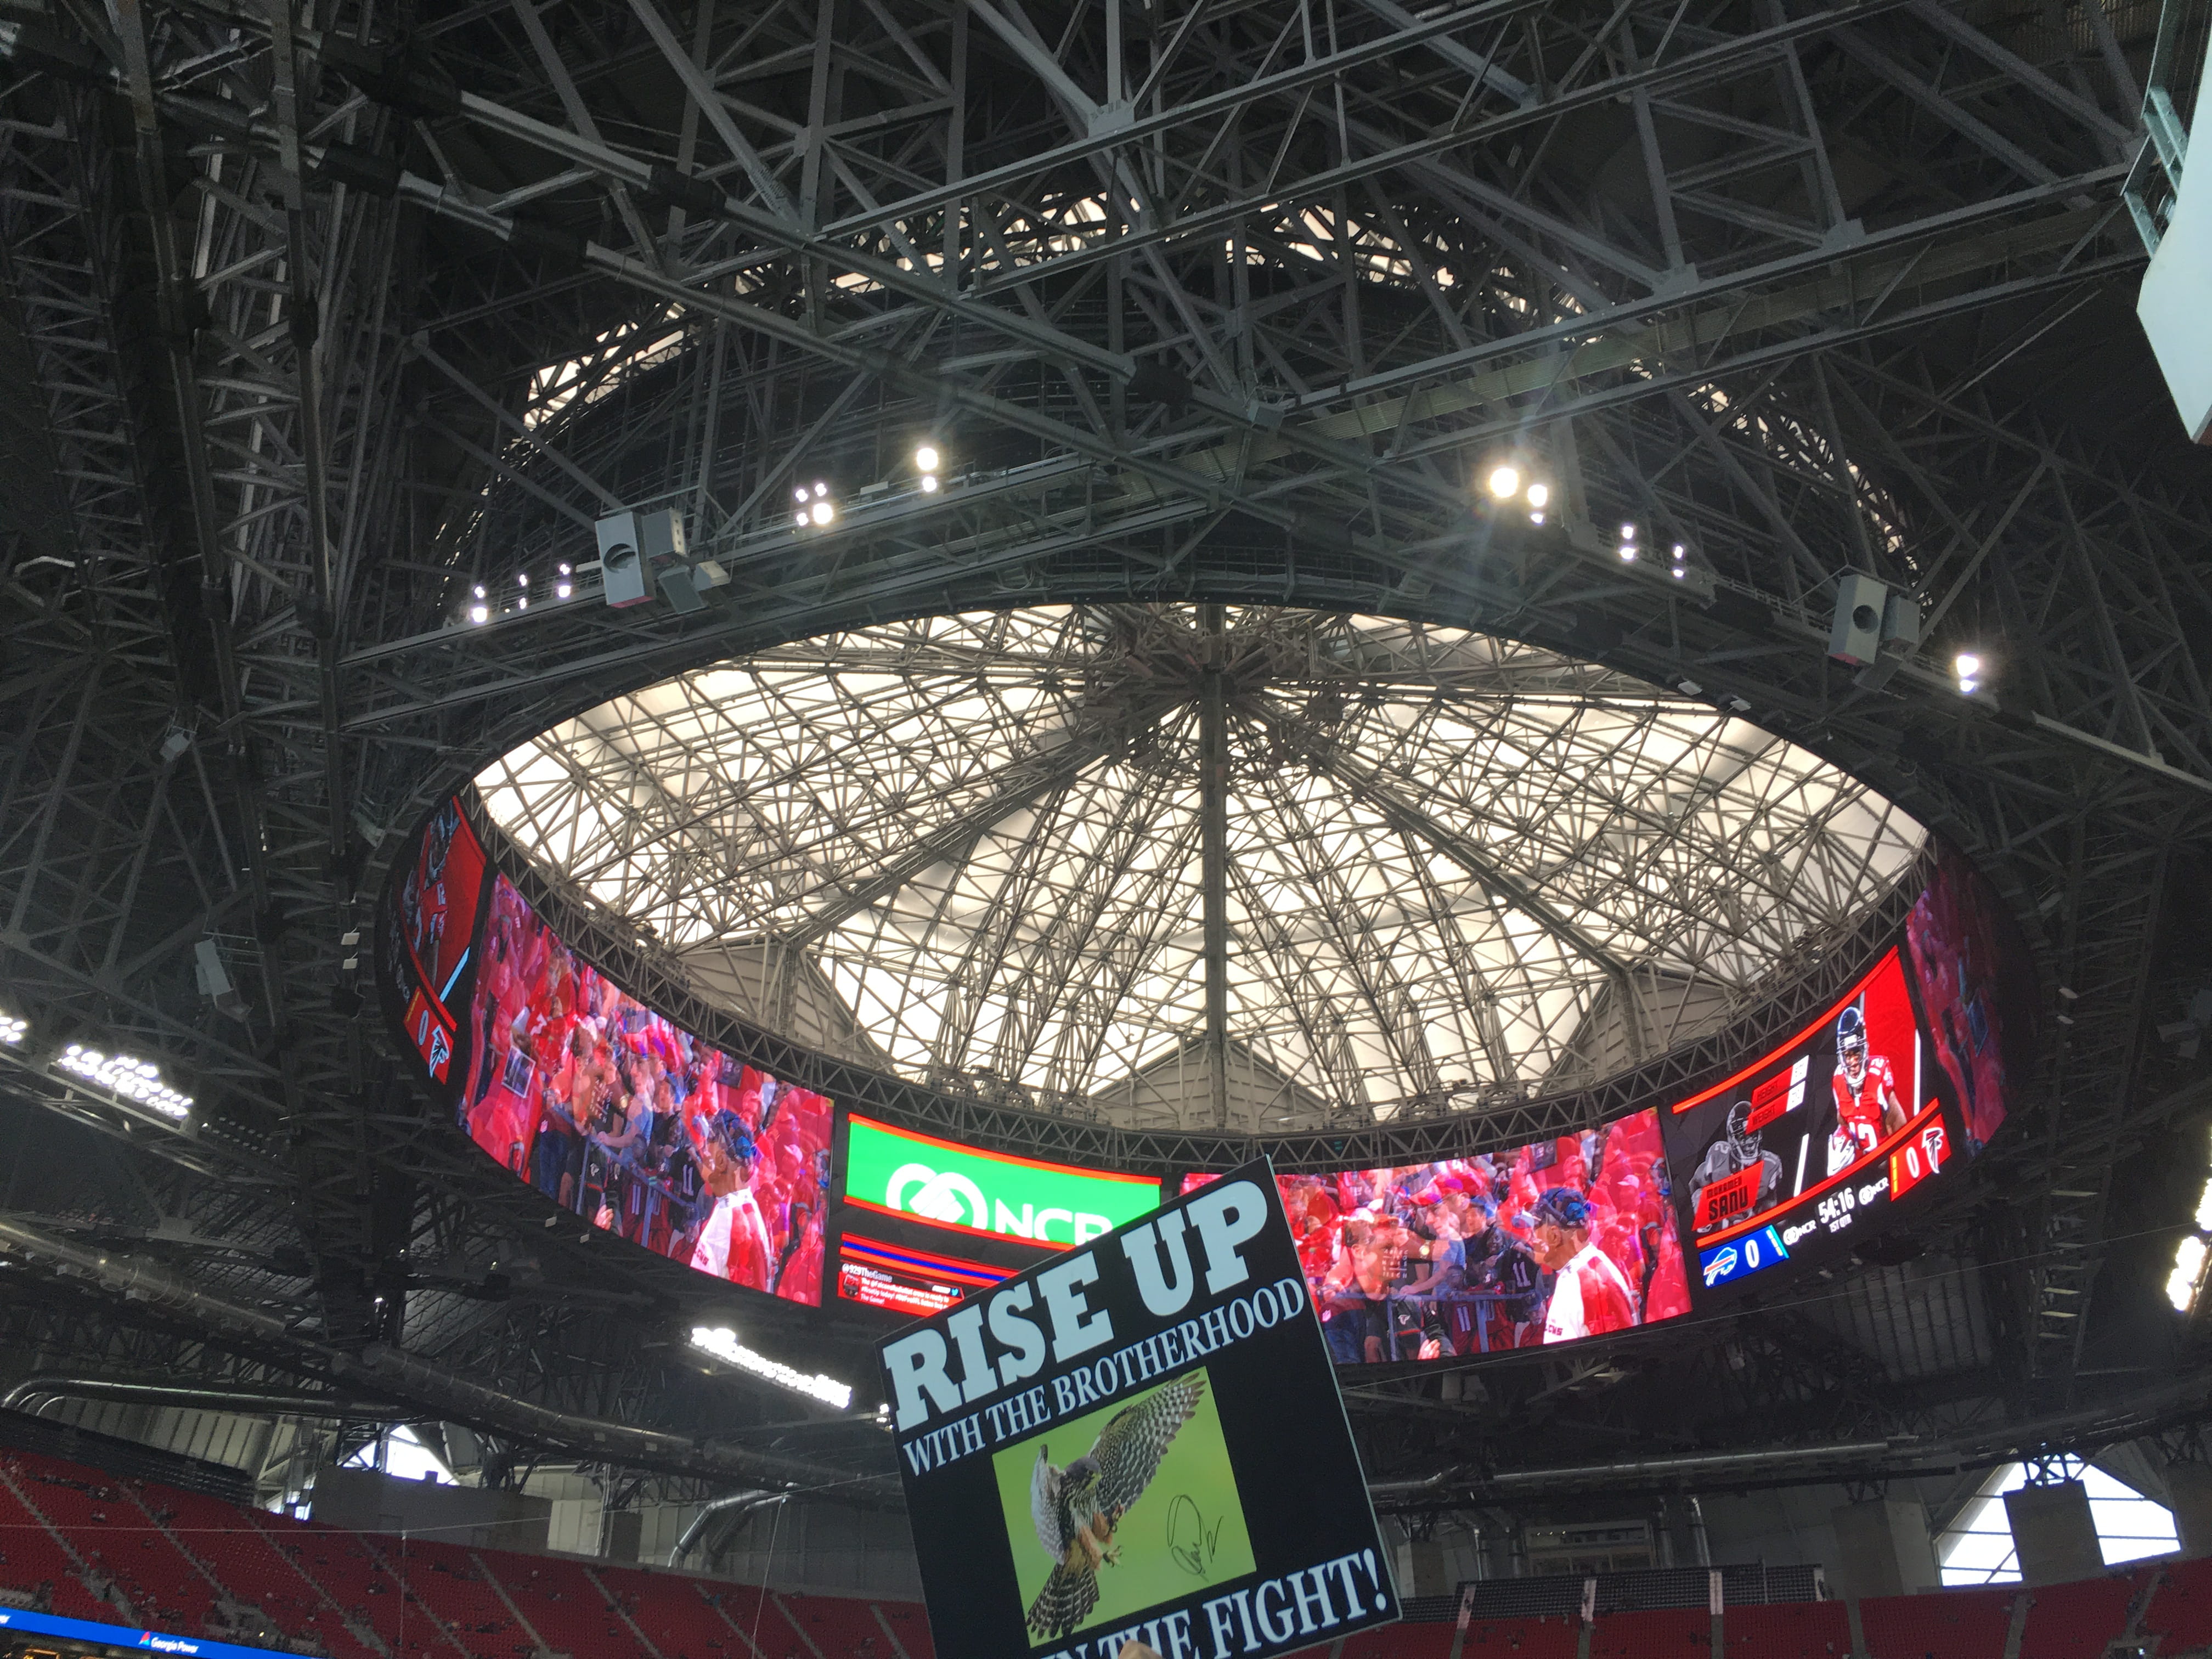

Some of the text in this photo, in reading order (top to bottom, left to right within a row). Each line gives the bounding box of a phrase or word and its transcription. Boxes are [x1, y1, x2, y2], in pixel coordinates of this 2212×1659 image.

[1905, 1147, 1920, 1178] 0
[1871, 1177, 1889, 1195] NCR
[1708, 1184, 1748, 1221] SANU
[1818, 1187, 1855, 1224] 54:16
[1798, 1220, 1817, 1235] NCR
[1745, 1239, 1760, 1268] 0
[842, 1263, 893, 1283] @929TheGame
[882, 1180, 1268, 1433] RISE UP
[902, 1277, 1305, 1477] WITH THE BROTHERHOOD
[1202, 1547, 1387, 1659] FIGHT!
[151, 1636, 199, 1654] Georgia Power
